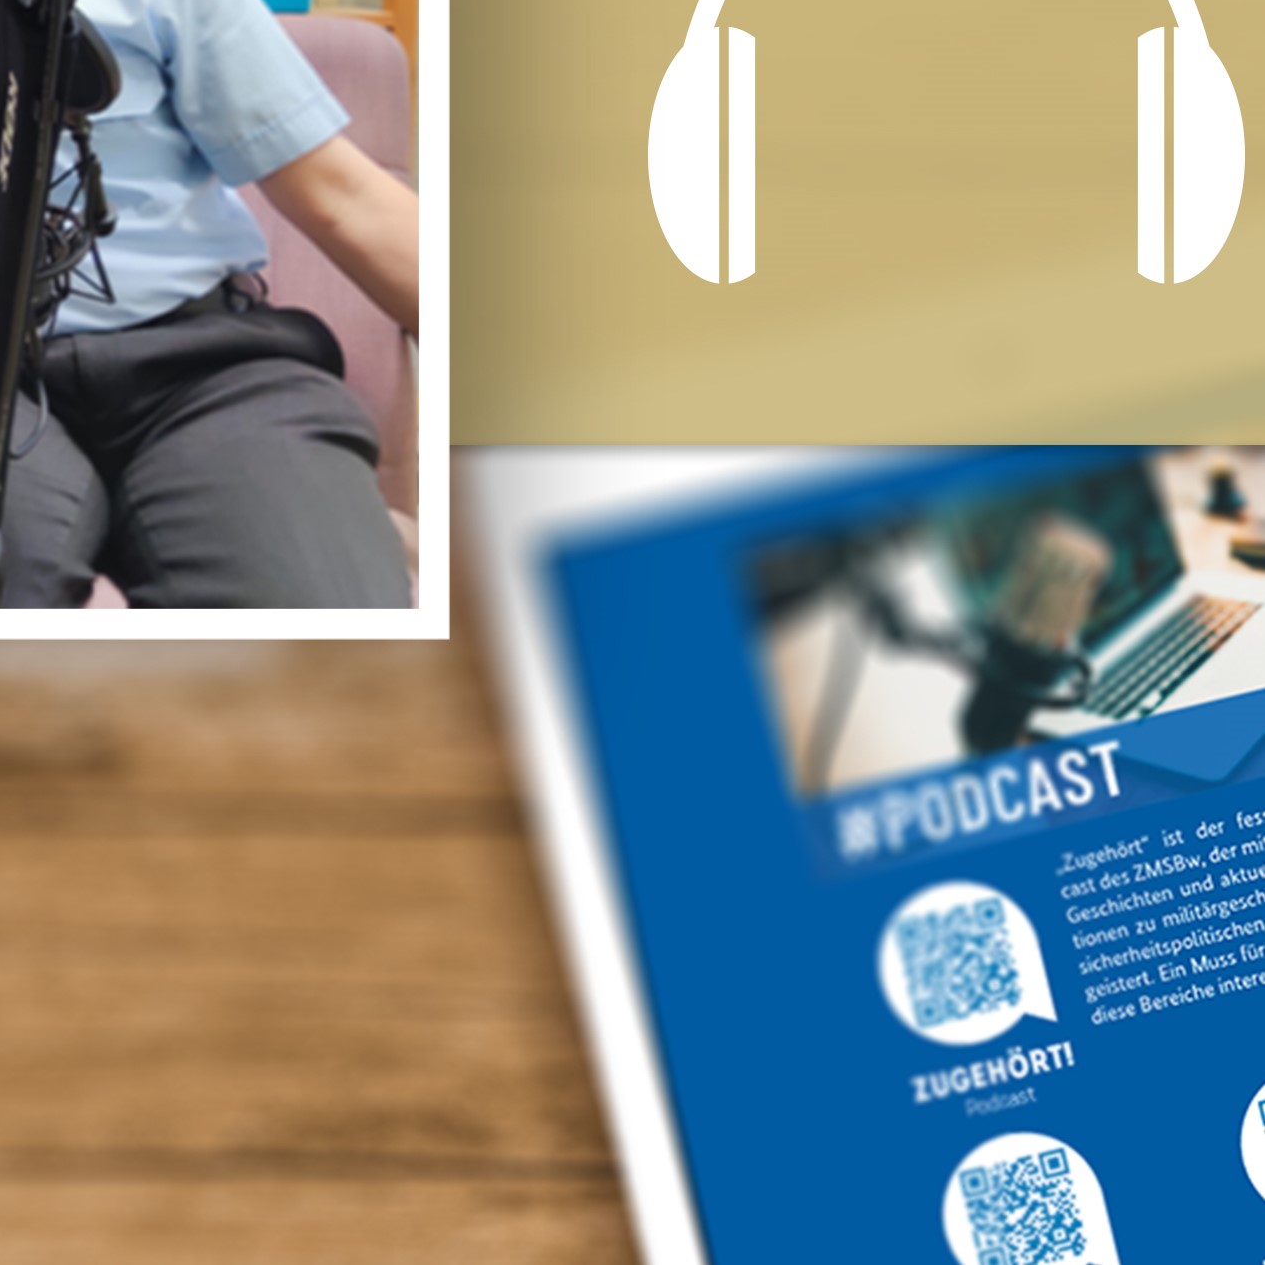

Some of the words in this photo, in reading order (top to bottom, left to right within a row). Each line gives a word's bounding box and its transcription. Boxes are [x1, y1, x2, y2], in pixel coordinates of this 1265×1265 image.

[838, 739, 1122, 862] #PODCAST
[1161, 829, 1184, 848] ist
[1196, 820, 1225, 840] der
[1060, 878, 1097, 899] cast
[1100, 871, 1130, 890] des
[1133, 854, 1208, 882] ZMSBw,
[1209, 845, 1237, 864] der
[1065, 887, 1174, 924] Geschichten
[1180, 874, 1215, 898] und
[1072, 925, 1130, 950] tionen
[1135, 919, 1157, 936] zu
[1162, 889, 1265, 928] militärgesch
[1079, 919, 1265, 975] sicherheitspolitischen
[1084, 971, 1156, 1004] geistert.
[1158, 962, 1187, 983] Ein
[1190, 951, 1238, 974] Muss
[1240, 942, 1265, 963] für
[1091, 1002, 1136, 1025] diese
[1139, 984, 1215, 1014] Bereiche
[911, 1041, 1076, 1103] ZUGEHÖRT!
[965, 1087, 1037, 1117] Podcast
